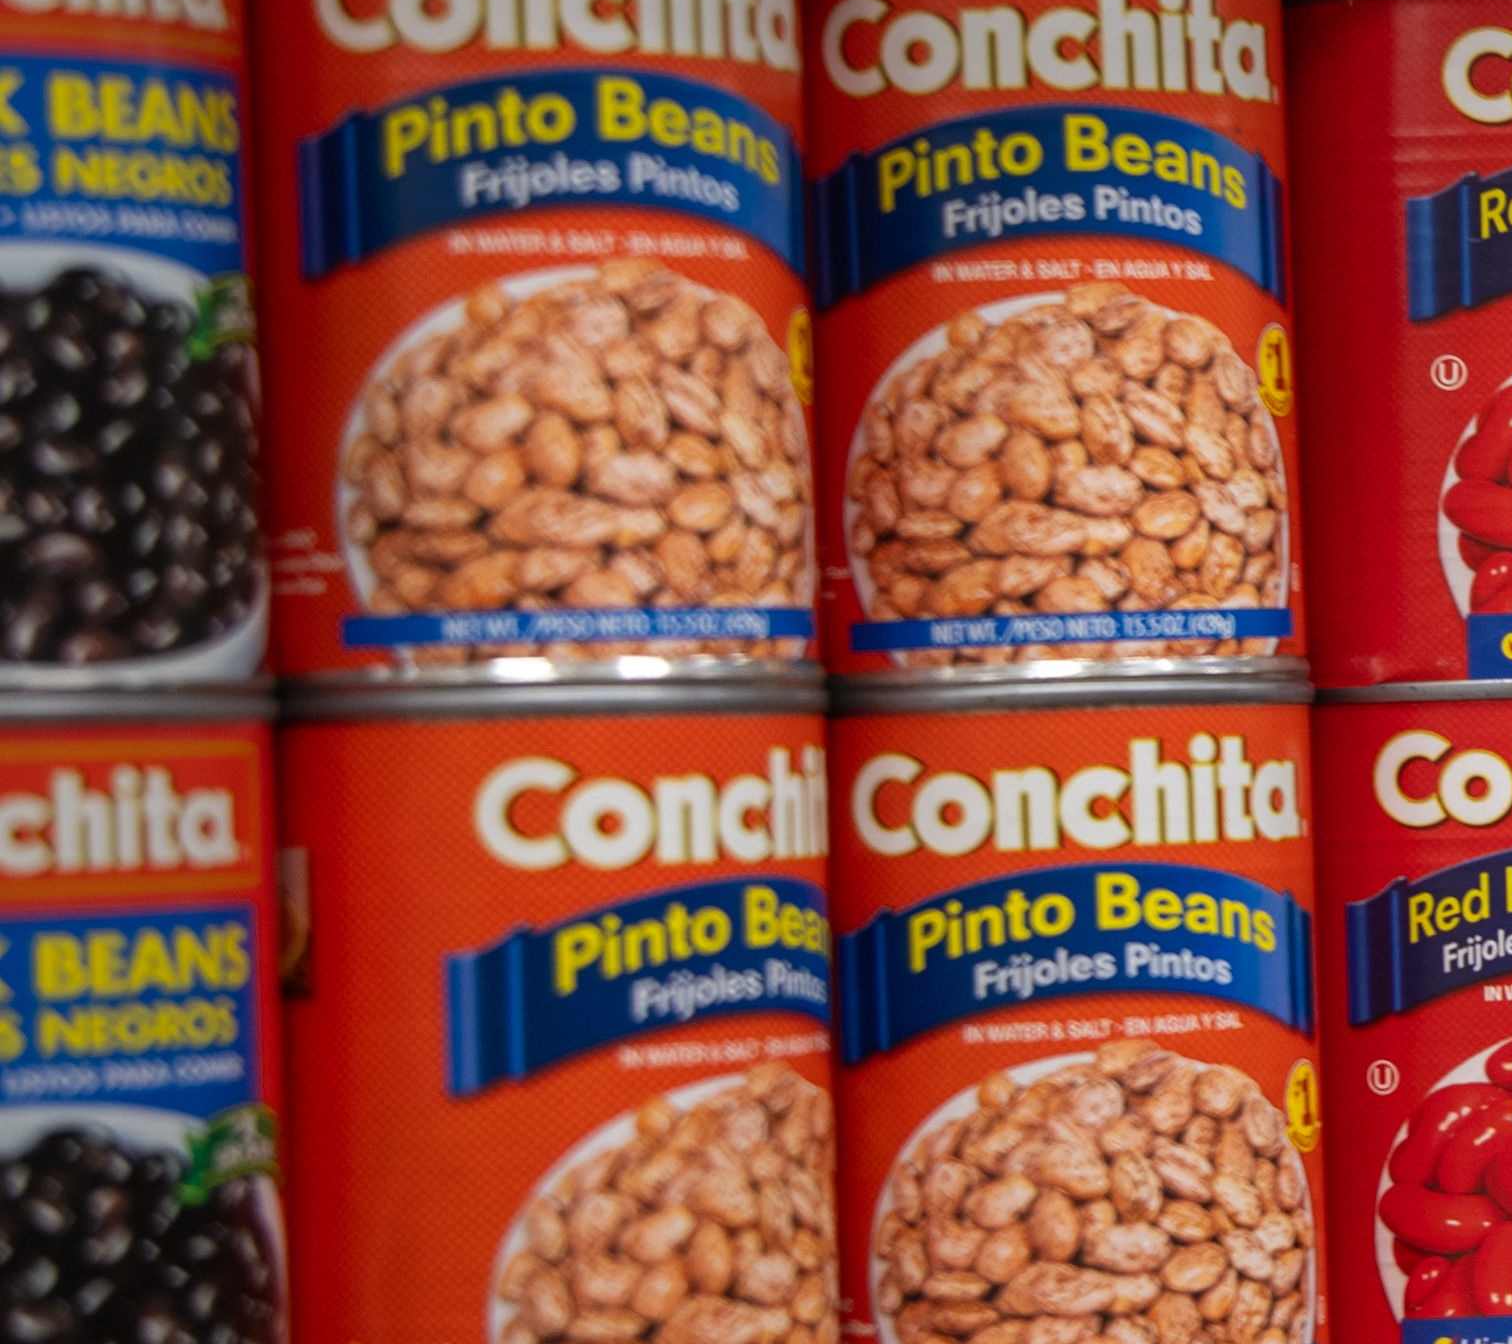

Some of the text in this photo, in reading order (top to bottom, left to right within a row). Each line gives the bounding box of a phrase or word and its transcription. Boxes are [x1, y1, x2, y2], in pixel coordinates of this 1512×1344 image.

[384, 76, 782, 185] Pinto Beans
[460, 150, 741, 213] Frijoles Pintos
[876, 113, 1248, 214] Pinto Beans
[943, 183, 1203, 240] Frijoles Pintos
[850, 731, 1299, 859] Conchita
[908, 871, 1277, 973] Pinto Beans
[631, 964, 762, 1023] Frijoles
[972, 943, 1233, 1001] Frijoles Pintos
[34, 998, 238, 1055] NEGROS
